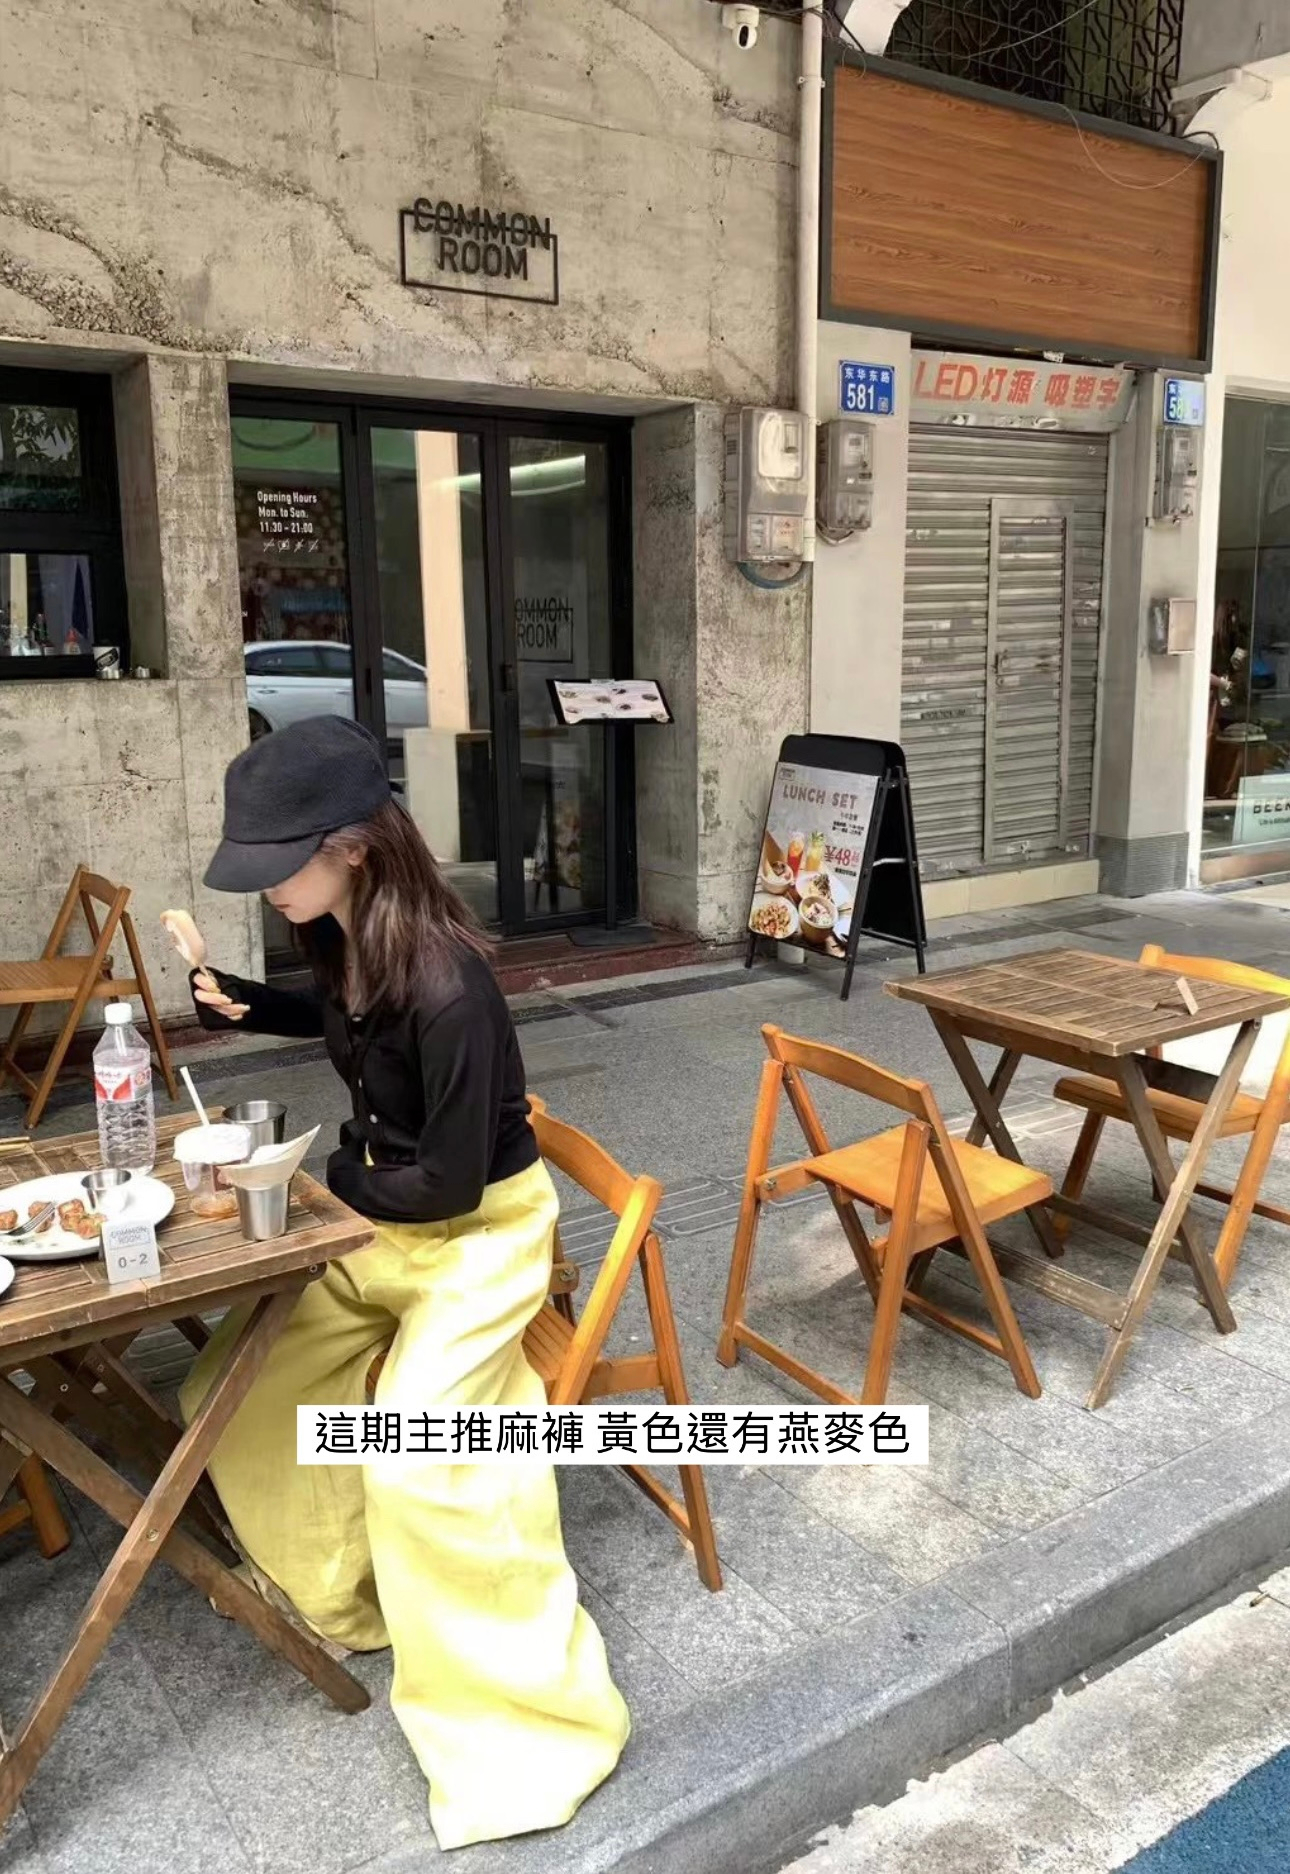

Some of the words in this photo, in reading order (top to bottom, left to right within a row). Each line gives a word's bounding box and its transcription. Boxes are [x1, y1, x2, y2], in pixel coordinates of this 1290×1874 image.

[413, 197, 550, 250] COMMON
[436, 236, 528, 281] ROOM
[845, 367, 890, 384] 东华东路
[913, 361, 1036, 406] LED灯源
[1045, 373, 1121, 410] 吸塑字
[847, 383, 875, 410] 581
[257, 491, 292, 505] Opening
[293, 491, 318, 503] Hours
[280, 507, 289, 518] to
[515, 597, 569, 622] OMMON
[517, 623, 558, 649] ROOM
[783, 784, 826, 804] LUNCH
[832, 791, 858, 809] SET
